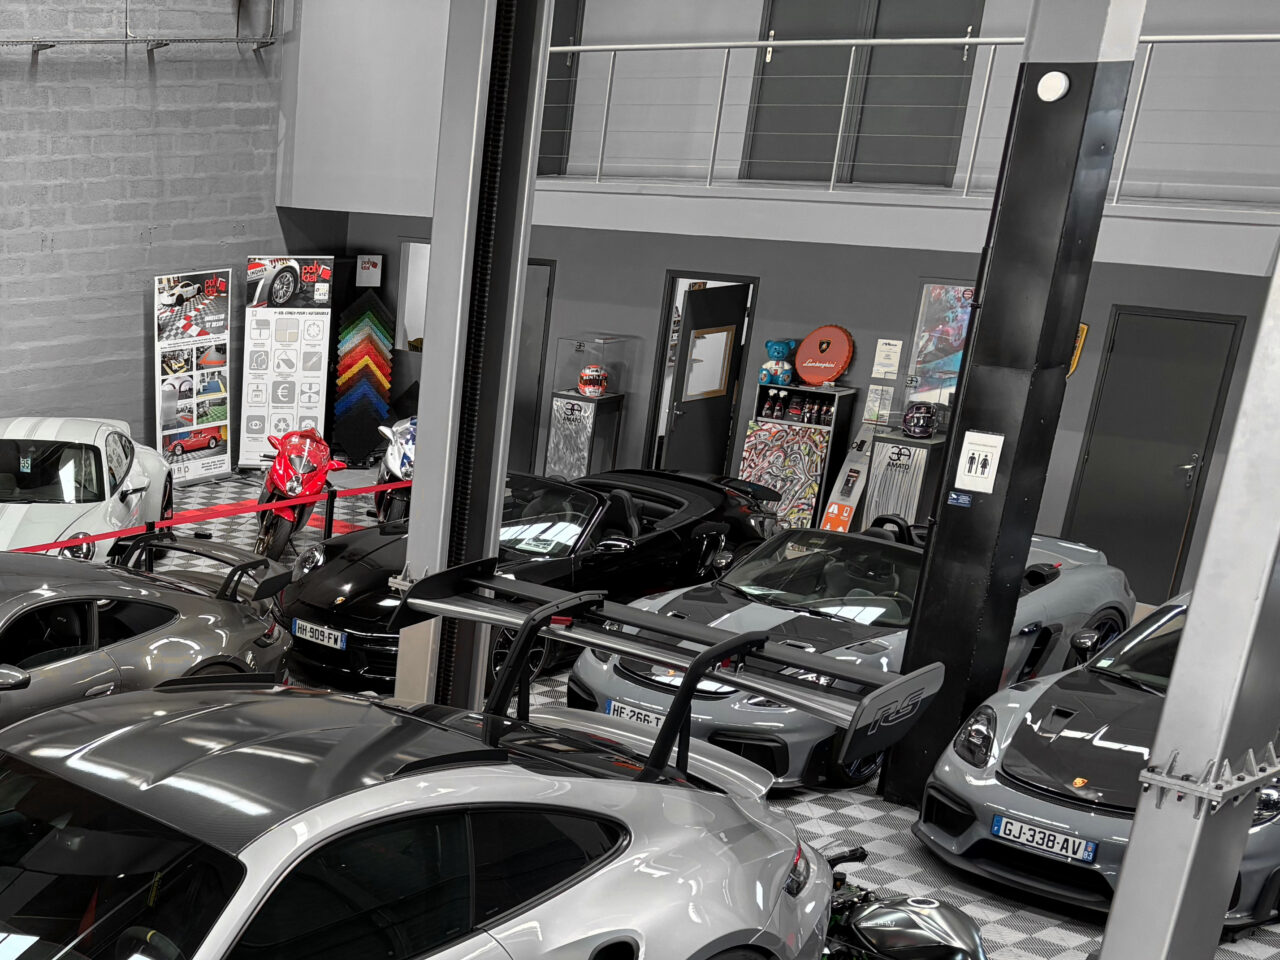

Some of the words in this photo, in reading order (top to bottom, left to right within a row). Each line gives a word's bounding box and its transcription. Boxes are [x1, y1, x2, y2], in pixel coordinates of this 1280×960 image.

[803, 359, 837, 368] Lamborghini
[887, 461, 910, 471] AMATO
[297, 622, 339, 647] HH-909-FW
[868, 687, 925, 735] RS
[1003, 821, 1082, 856] GJ-338-AV
